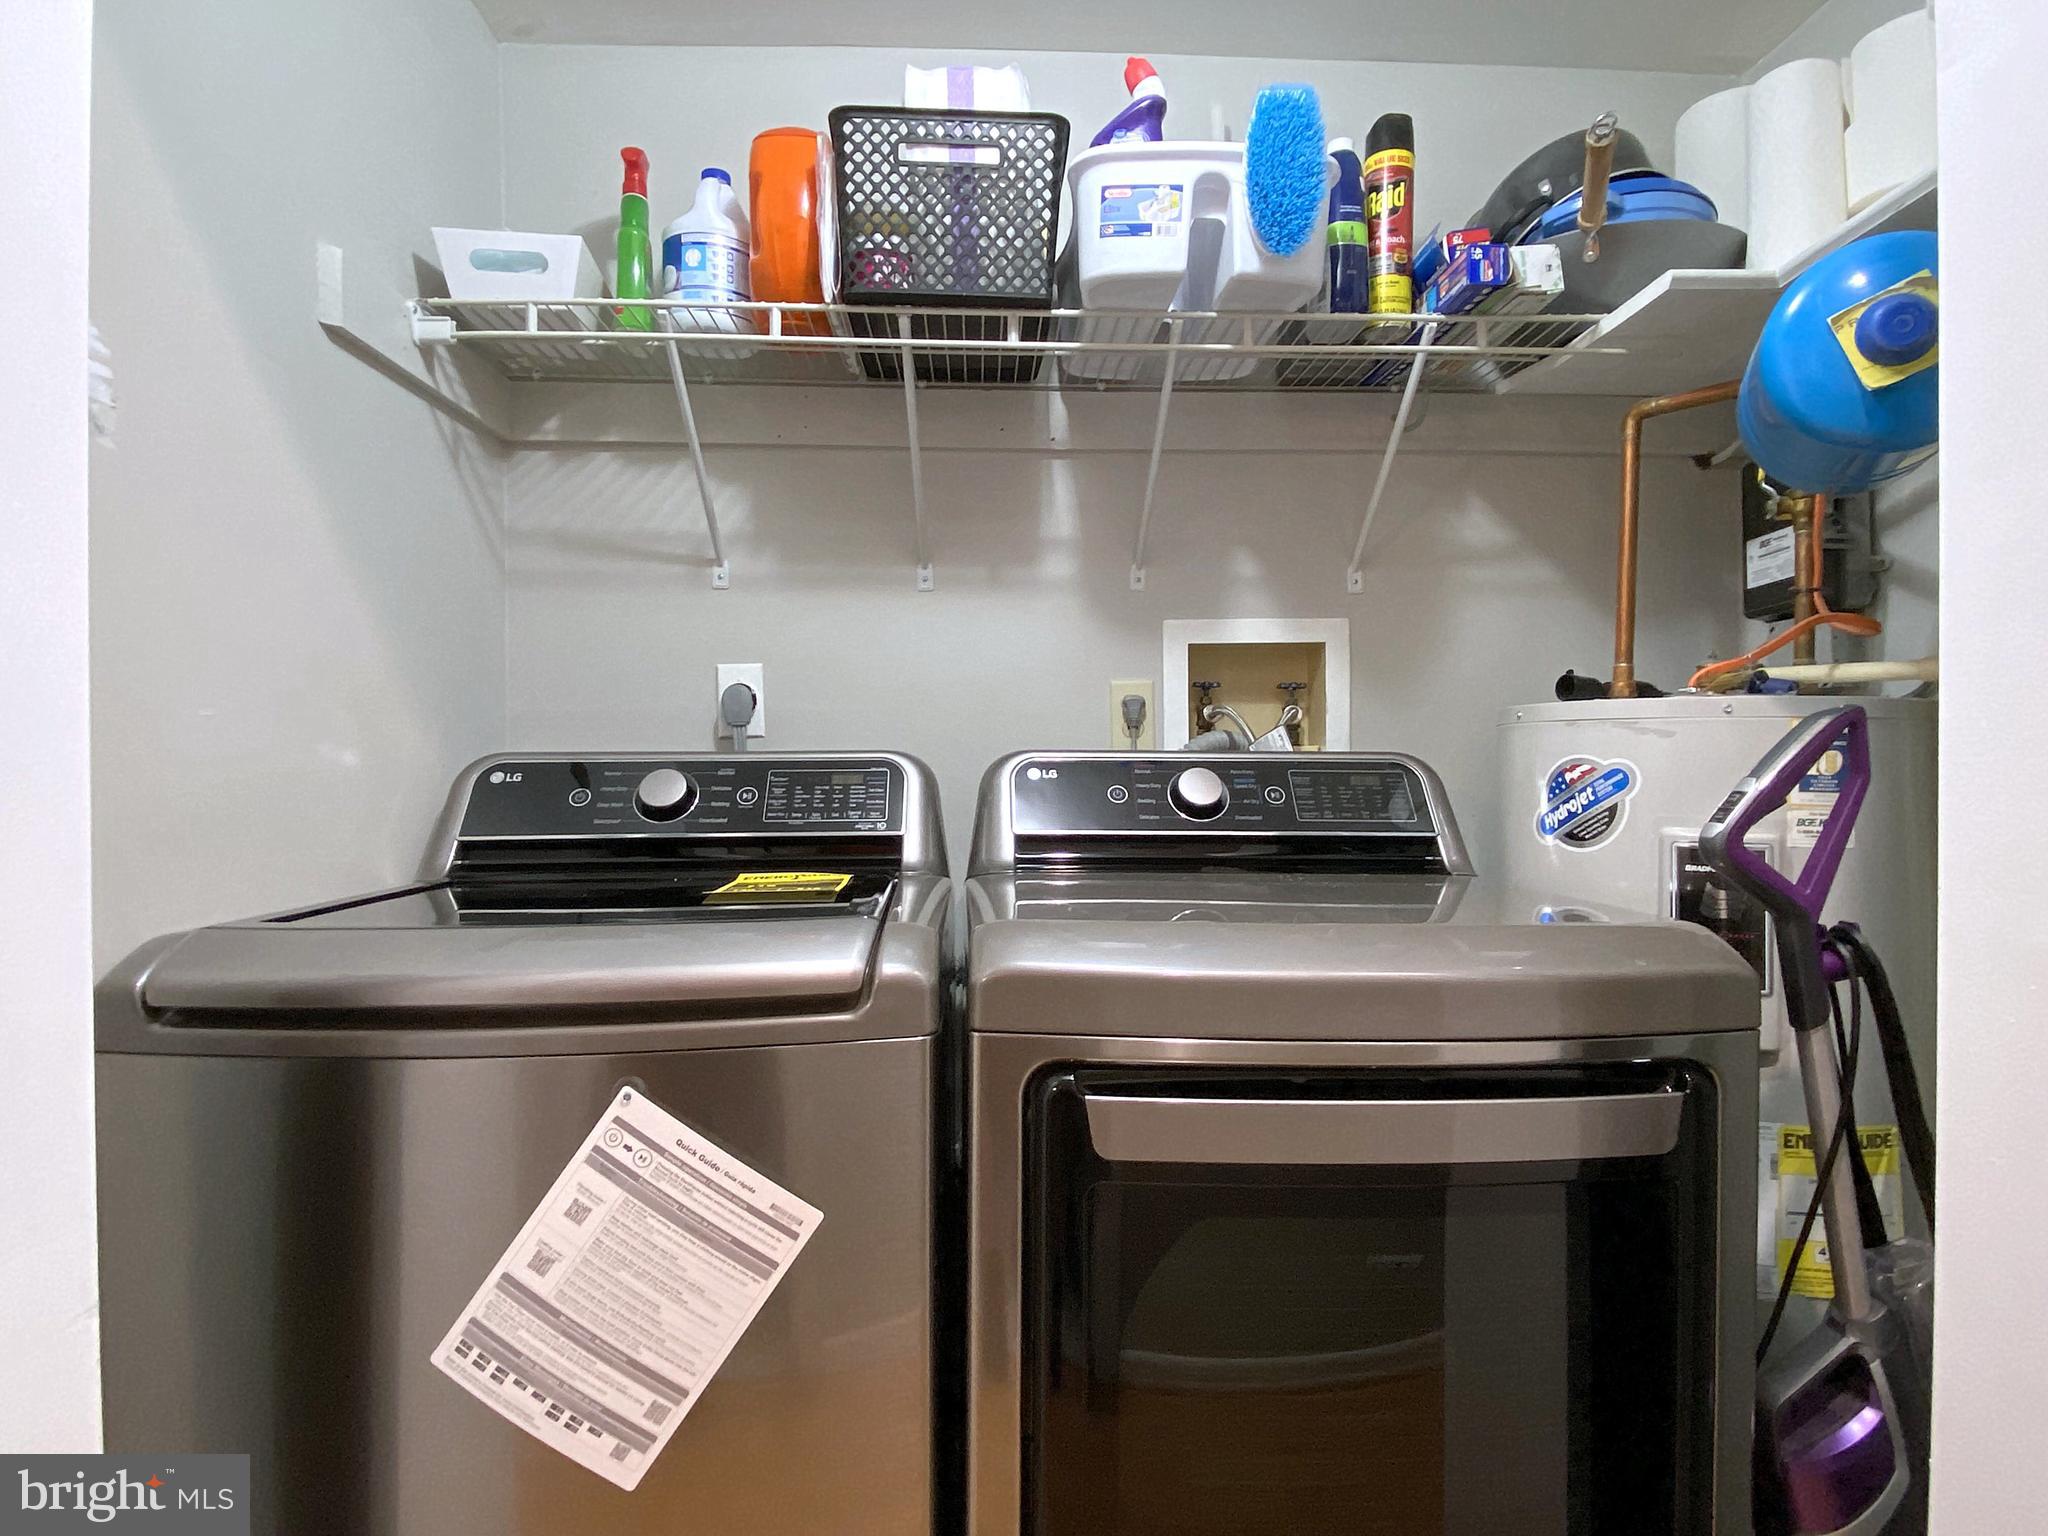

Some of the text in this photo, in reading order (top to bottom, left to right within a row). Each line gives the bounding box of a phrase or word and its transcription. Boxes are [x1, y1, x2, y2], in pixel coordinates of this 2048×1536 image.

[1366, 182, 1405, 218] Raid
[506, 772, 523, 782] LG
[1042, 769, 1058, 779] LG
[1544, 785, 1595, 830] Hydrojet
[676, 1138, 697, 1158] Quick
[698, 1153, 720, 1172] Guide
